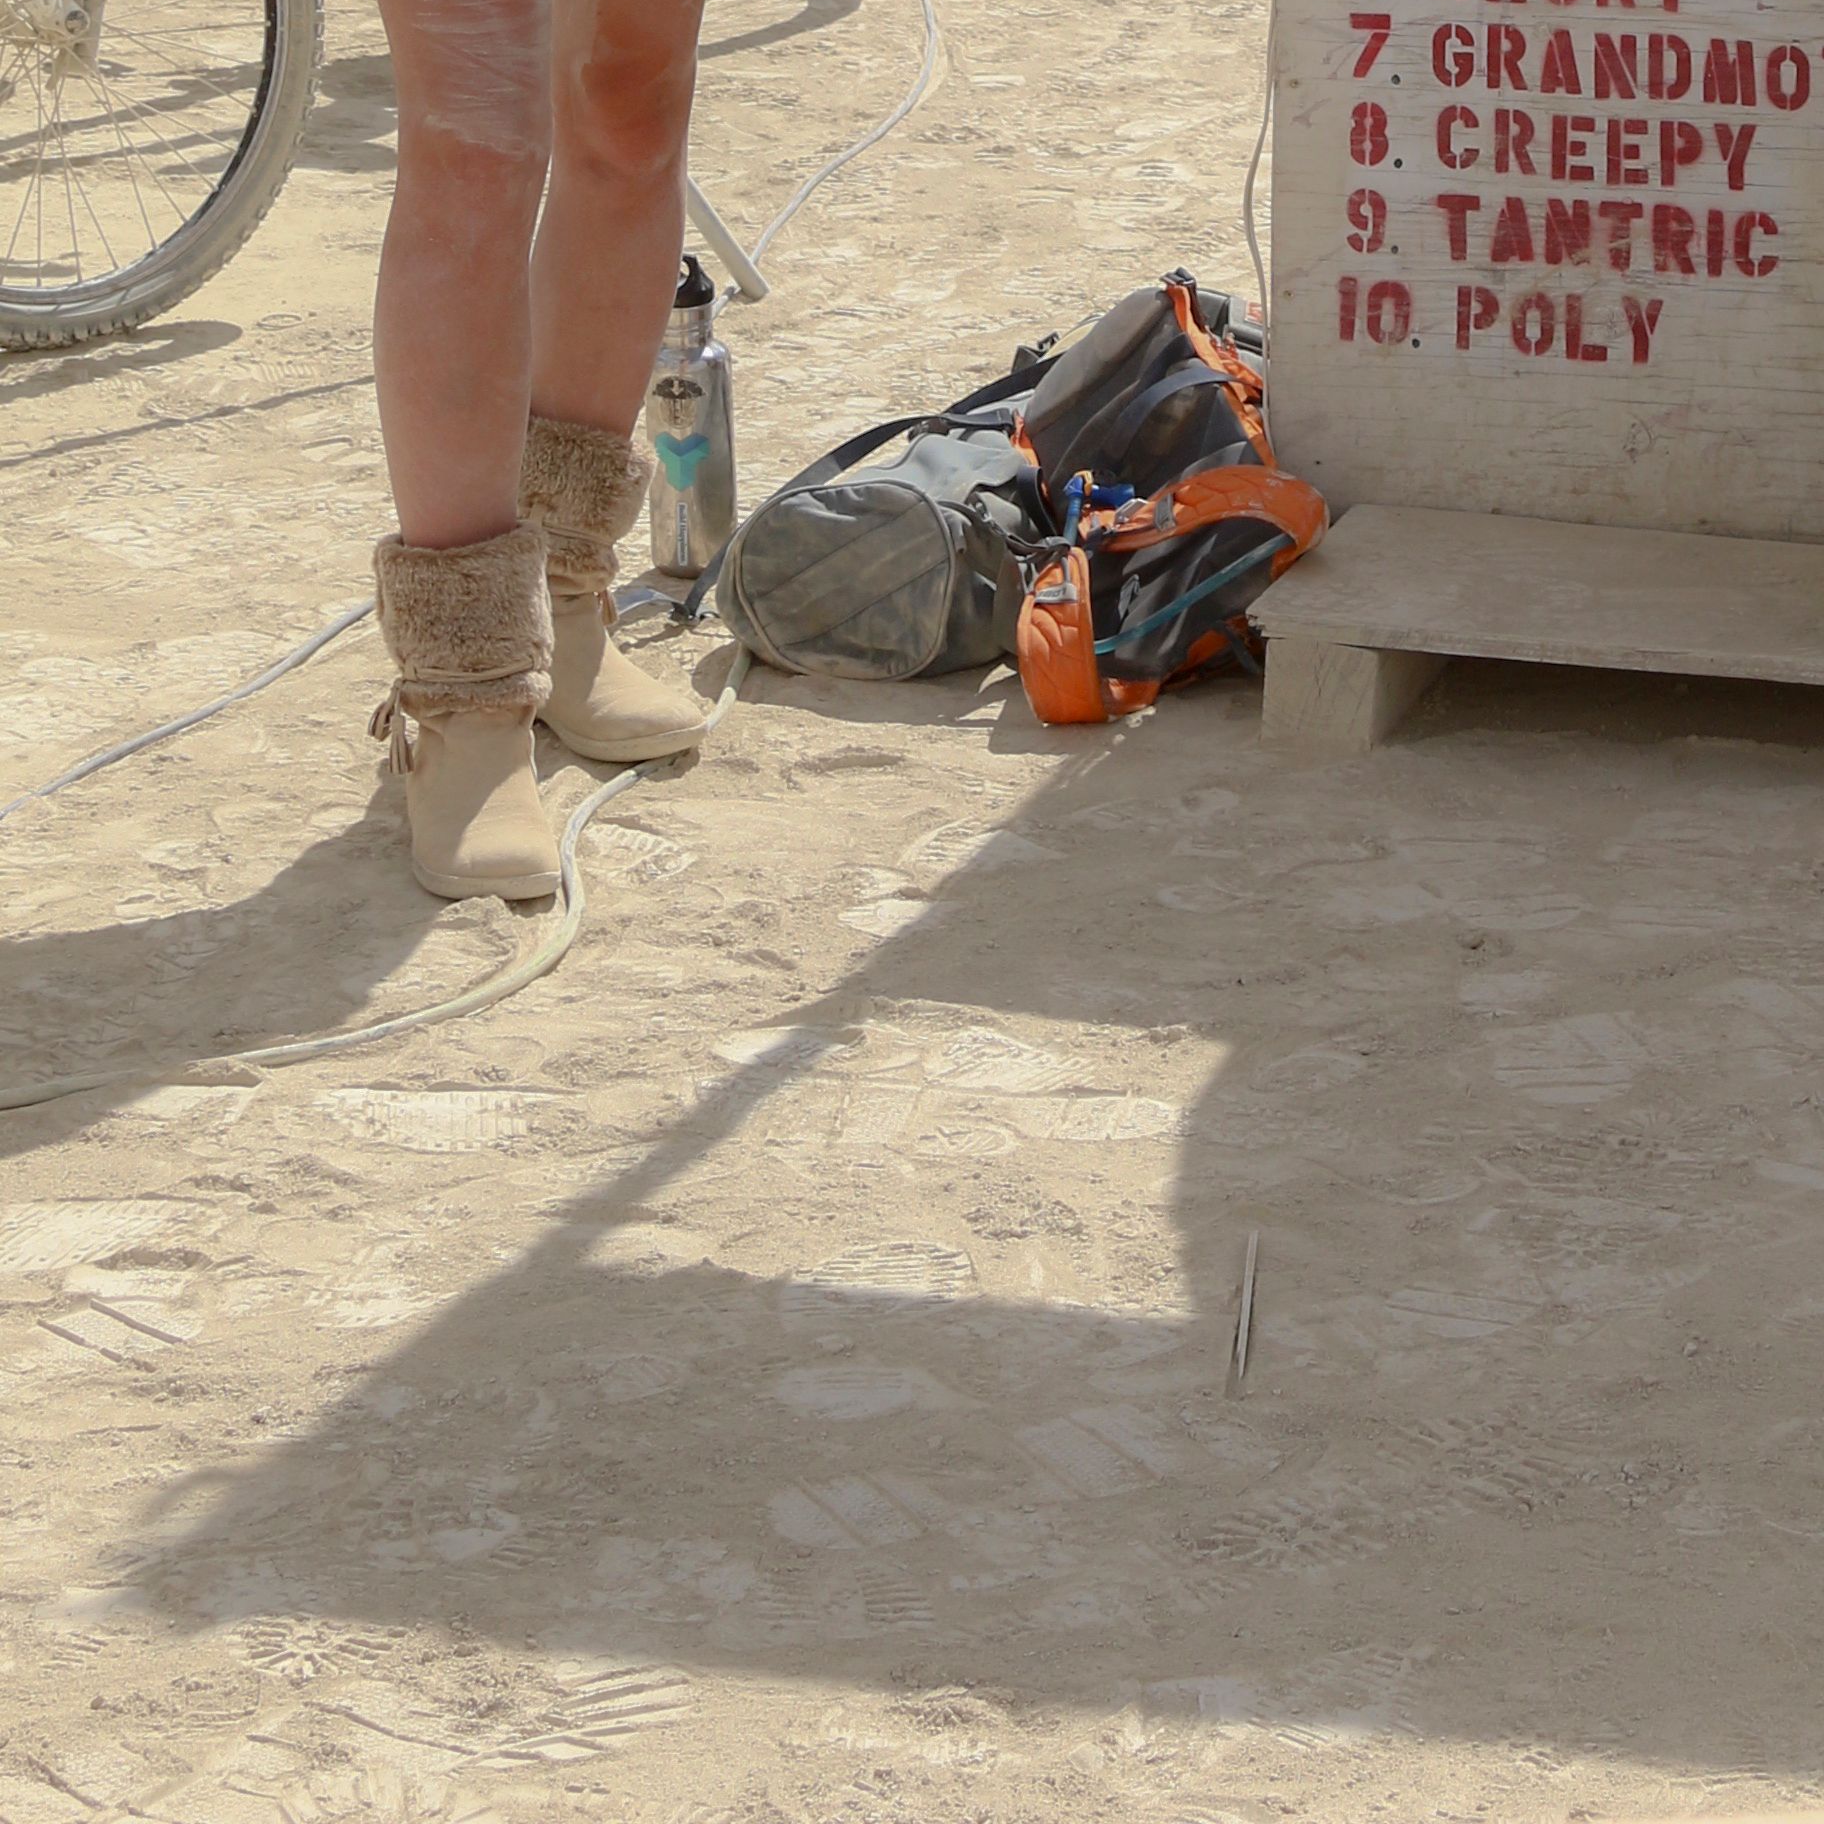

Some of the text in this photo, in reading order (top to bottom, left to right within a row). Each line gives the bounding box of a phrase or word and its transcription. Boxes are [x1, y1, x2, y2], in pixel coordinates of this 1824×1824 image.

[1437, 104, 1757, 192] CREEPY
[1437, 193, 1779, 278] TANTRIC
[1456, 285, 1663, 364] POLY
